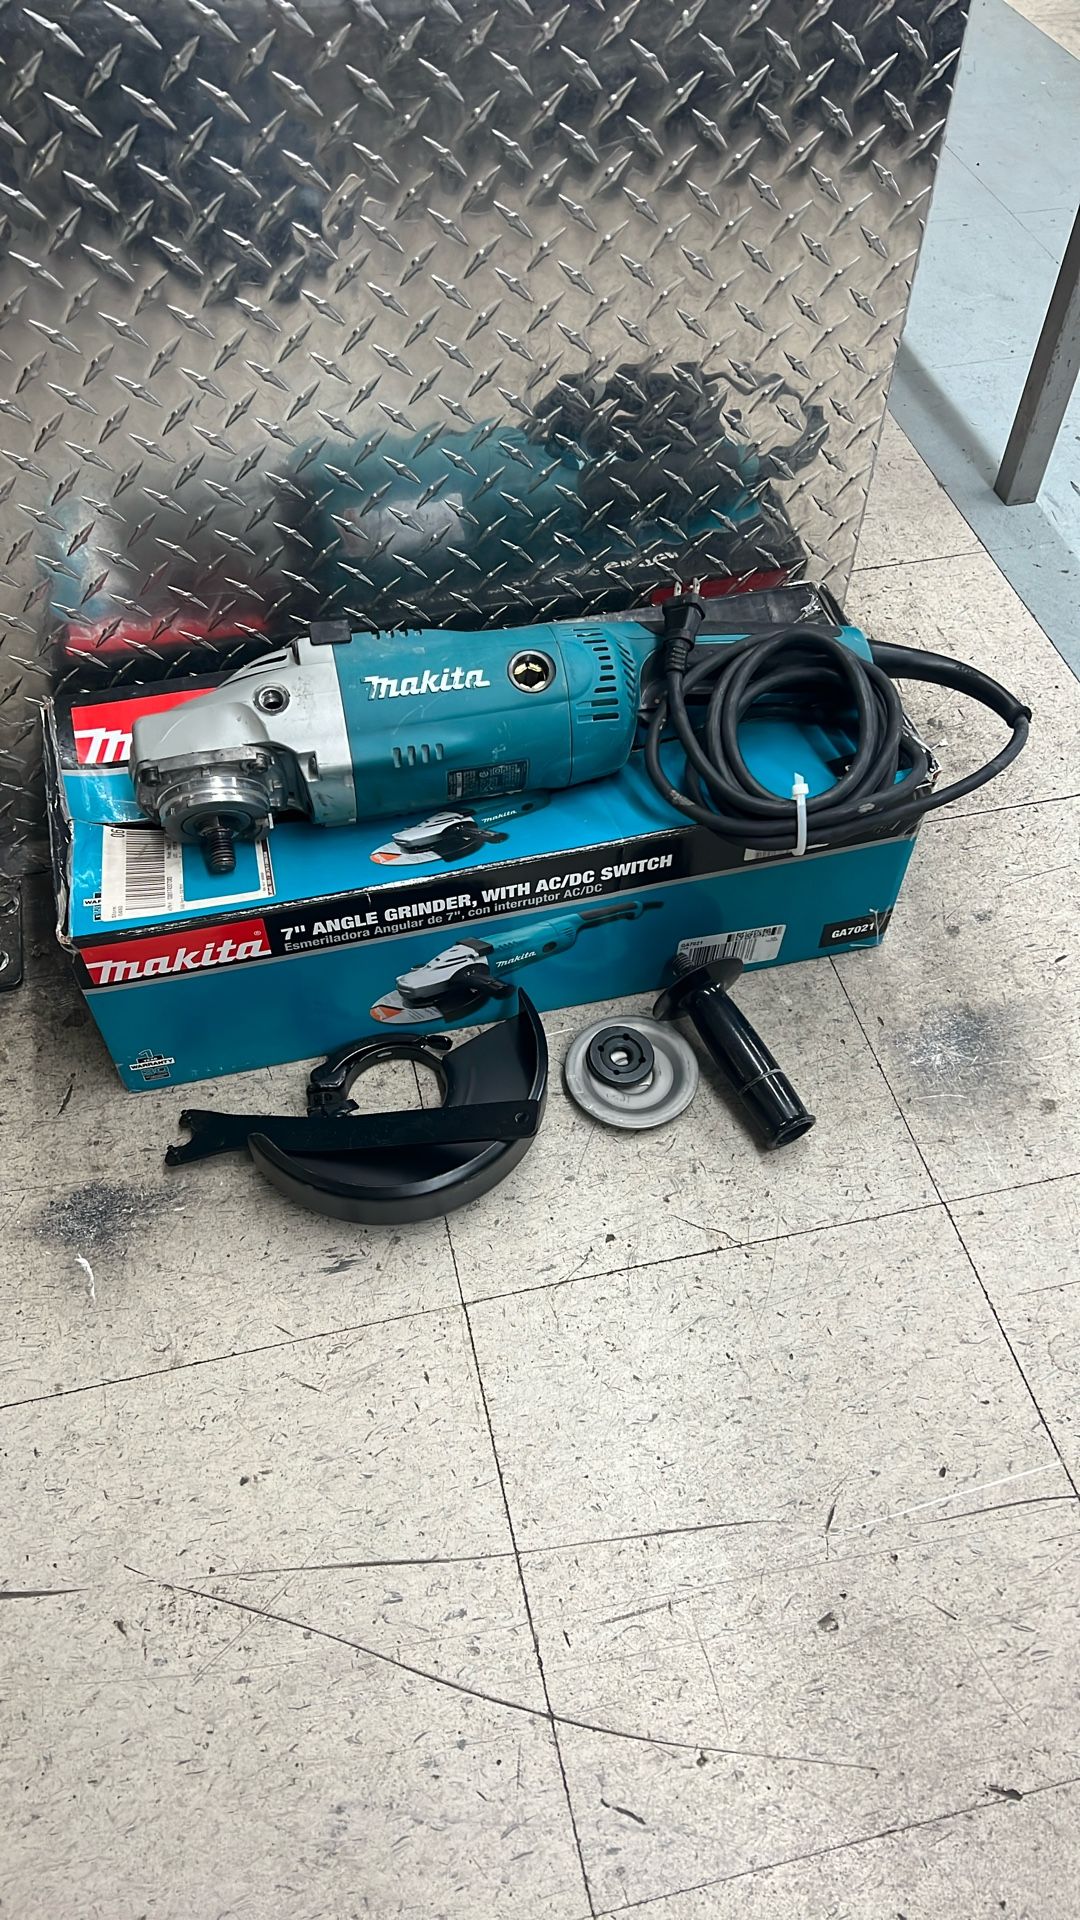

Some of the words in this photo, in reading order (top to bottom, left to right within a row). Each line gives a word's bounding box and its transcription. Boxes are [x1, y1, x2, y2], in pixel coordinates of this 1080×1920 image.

[280, 925, 306, 941] 7"
[312, 911, 379, 935] ANGLE
[384, 893, 478, 922] GRINDER,
[482, 882, 531, 903] WITH
[535, 870, 595, 892] AC/DC
[600, 854, 673, 881] SWITCH
[284, 930, 370, 952] Esmeriladora
[374, 919, 424, 935] Angular
[427, 915, 443, 926] de
[467, 905, 491, 917] con
[494, 892, 560, 912] interruptor
[563, 883, 603, 899] AC/DC
[831, 922, 875, 938] GA7021
[131, 1059, 173, 1069] WARRANTY
